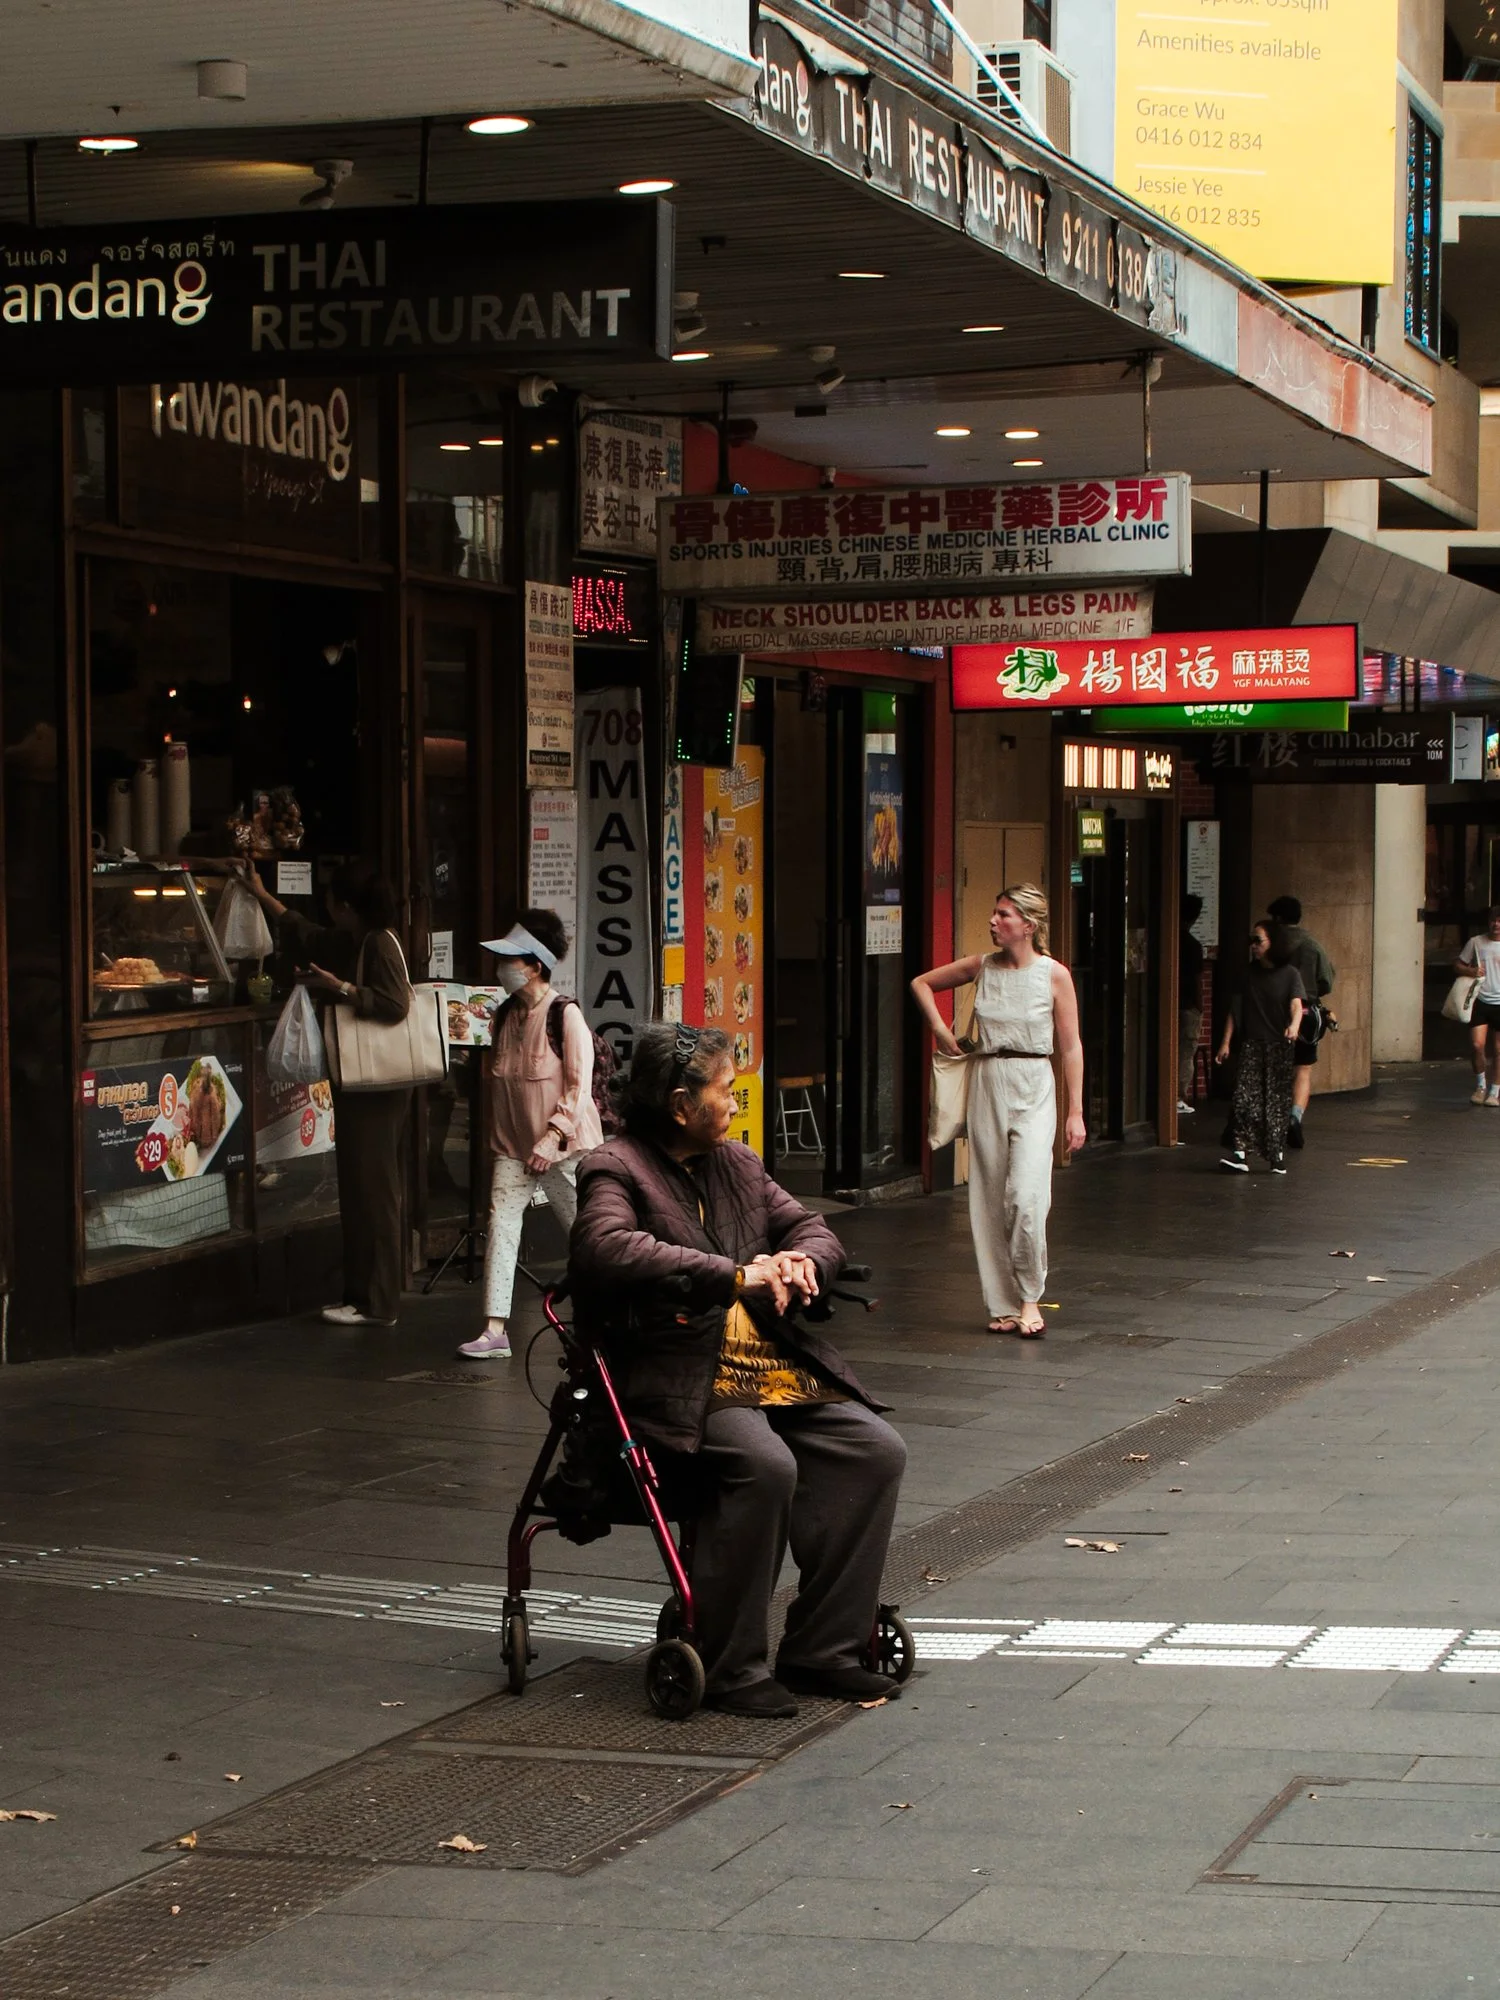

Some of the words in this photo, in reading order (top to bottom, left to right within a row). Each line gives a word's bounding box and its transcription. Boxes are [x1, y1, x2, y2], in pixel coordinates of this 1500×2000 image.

[1137, 29, 1234, 54] Amenities
[1241, 39, 1322, 61] available
[1136, 98, 1189, 117] Grace
[1194, 101, 1225, 120] Wu
[1136, 126, 1183, 145] 0416
[1189, 129, 1223, 149] 012
[1229, 132, 1263, 151] 834
[834, 77, 893, 169] THAI
[908, 118, 1045, 250] RESTAURANT
[1062, 212, 1099, 281] 9211
[1135, 175, 1187, 195] Jessie
[1192, 178, 1223, 198] Yee
[1187, 206, 1221, 225] 012
[1227, 209, 1261, 228] 835
[253, 240, 386, 293] THAI
[0, 261, 213, 326] andang
[252, 288, 631, 352] RESTAURANT
[669, 543, 743, 562] SPORTS
[749, 538, 833, 559] INJURIES
[838, 534, 920, 554] CHINESE
[927, 530, 1017, 550] MEDICINE
[1024, 527, 1102, 546] HERBAL
[1108, 523, 1170, 542] CLINIC
[712, 606, 776, 630] NECK
[784, 601, 909, 627] SHOULDER
[915, 597, 980, 623] BACK
[989, 596, 1006, 619] &
[1014, 593, 1076, 617] LEGS
[1084, 591, 1139, 614] PAIN
[711, 633, 784, 651] REMEDIAL
[789, 631, 861, 649] MASSAGE
[865, 625, 965, 646] ACUPUNTURE
[969, 622, 1027, 641] HERBAL
[1032, 620, 1103, 638] MEDICINE
[1115, 618, 1135, 634] 1/F
[1079, 645, 1220, 694] 楊國福
[1231, 648, 1310, 676] 麻辣烫
[1233, 678, 1252, 688] YGF
[1255, 676, 1311, 687] MALATANG
[583, 709, 641, 747] 708
[1307, 727, 1420, 750] cinnabar
[1375, 757, 1412, 767] COCKTAILS
[1426, 750, 1443, 761] 10M
[165, 1091, 174, 1117] S
[144, 1139, 162, 1163] $29
